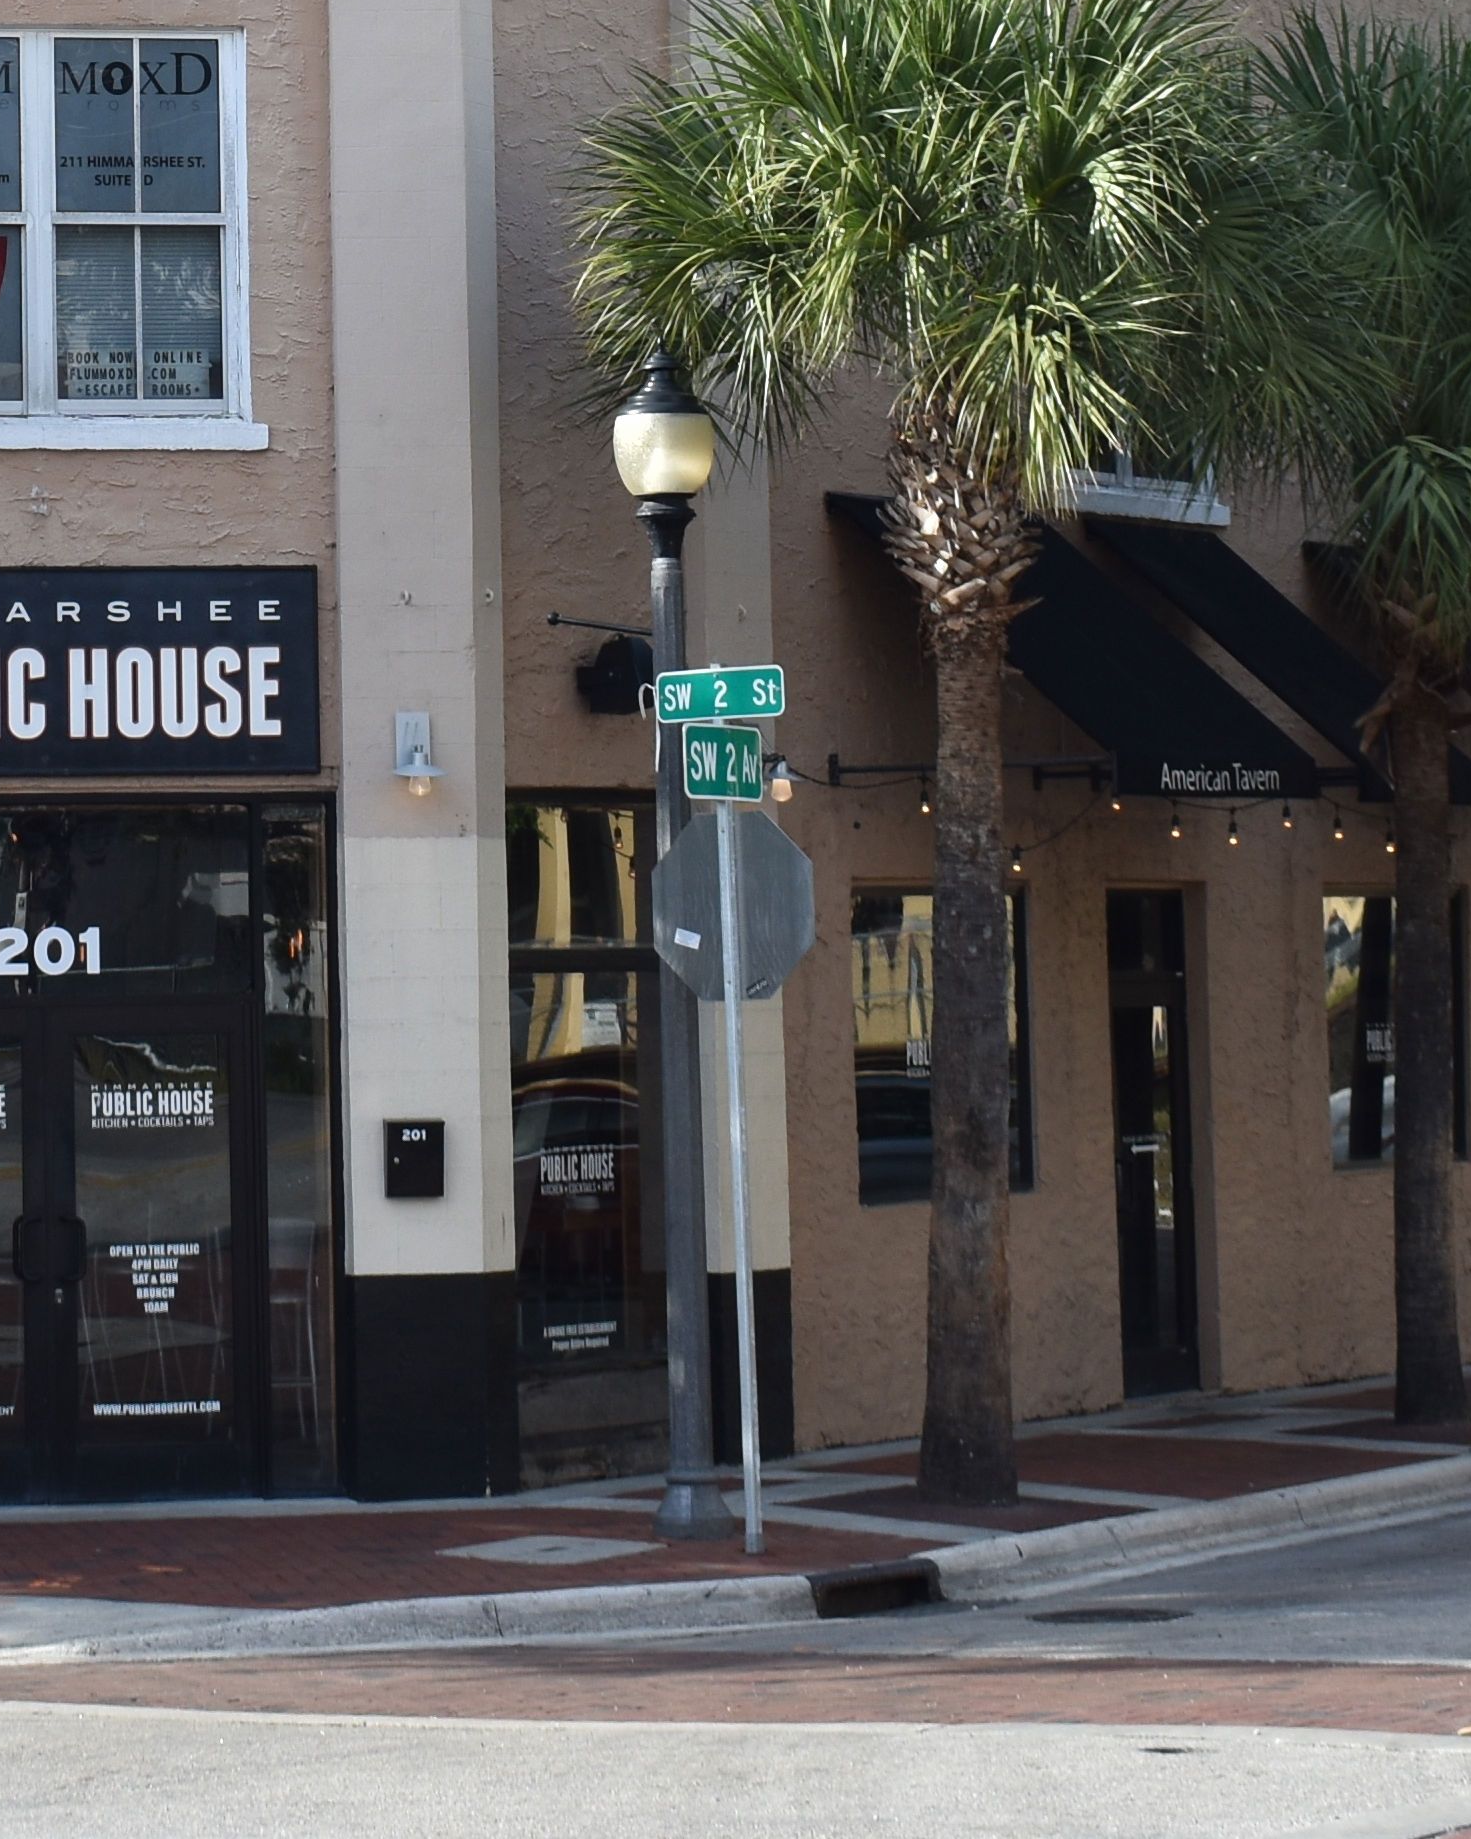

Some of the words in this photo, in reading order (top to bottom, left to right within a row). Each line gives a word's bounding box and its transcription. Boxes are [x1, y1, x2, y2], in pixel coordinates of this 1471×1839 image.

[60, 156, 83, 168] 211
[187, 156, 206, 168] ST.
[94, 174, 132, 187] SUITE
[143, 174, 154, 187] D
[68, 351, 99, 364] BOOK
[109, 351, 133, 364] NOW
[154, 351, 203, 364] ONLINE
[85, 383, 132, 396] ESCAPE
[152, 383, 192, 396] ROOMS
[68, 645, 282, 739] HOUSE
[664, 682, 692, 711] SW
[713, 679, 728, 709] 2
[752, 678, 777, 706] St
[690, 740, 718, 781] SW
[725, 742, 737, 782] 2
[1160, 762, 1231, 791] American
[1232, 762, 1280, 791] Tavern
[91, 1090, 153, 1117] PUBLIC
[158, 1089, 214, 1115] HOUSE
[91, 1118, 128, 1129] KITCHEN
[137, 1116, 184, 1128] COCKTAILS
[193, 1115, 214, 1127] TAPS
[401, 1128, 427, 1142] 201
[540, 1154, 579, 1182] PUBLIC
[580, 1152, 615, 1180] HOUSE
[109, 1244, 133, 1257] OPEN
[135, 1244, 147, 1257] TO
[148, 1244, 166, 1256] THE
[166, 1242, 200, 1256] PUBLIC
[131, 1258, 152, 1271] 4PM
[153, 1258, 179, 1271] DAILY
[132, 1272, 149, 1286] SAT
[136, 1286, 175, 1300] BRUNCH
[144, 1300, 169, 1313] 10AM
